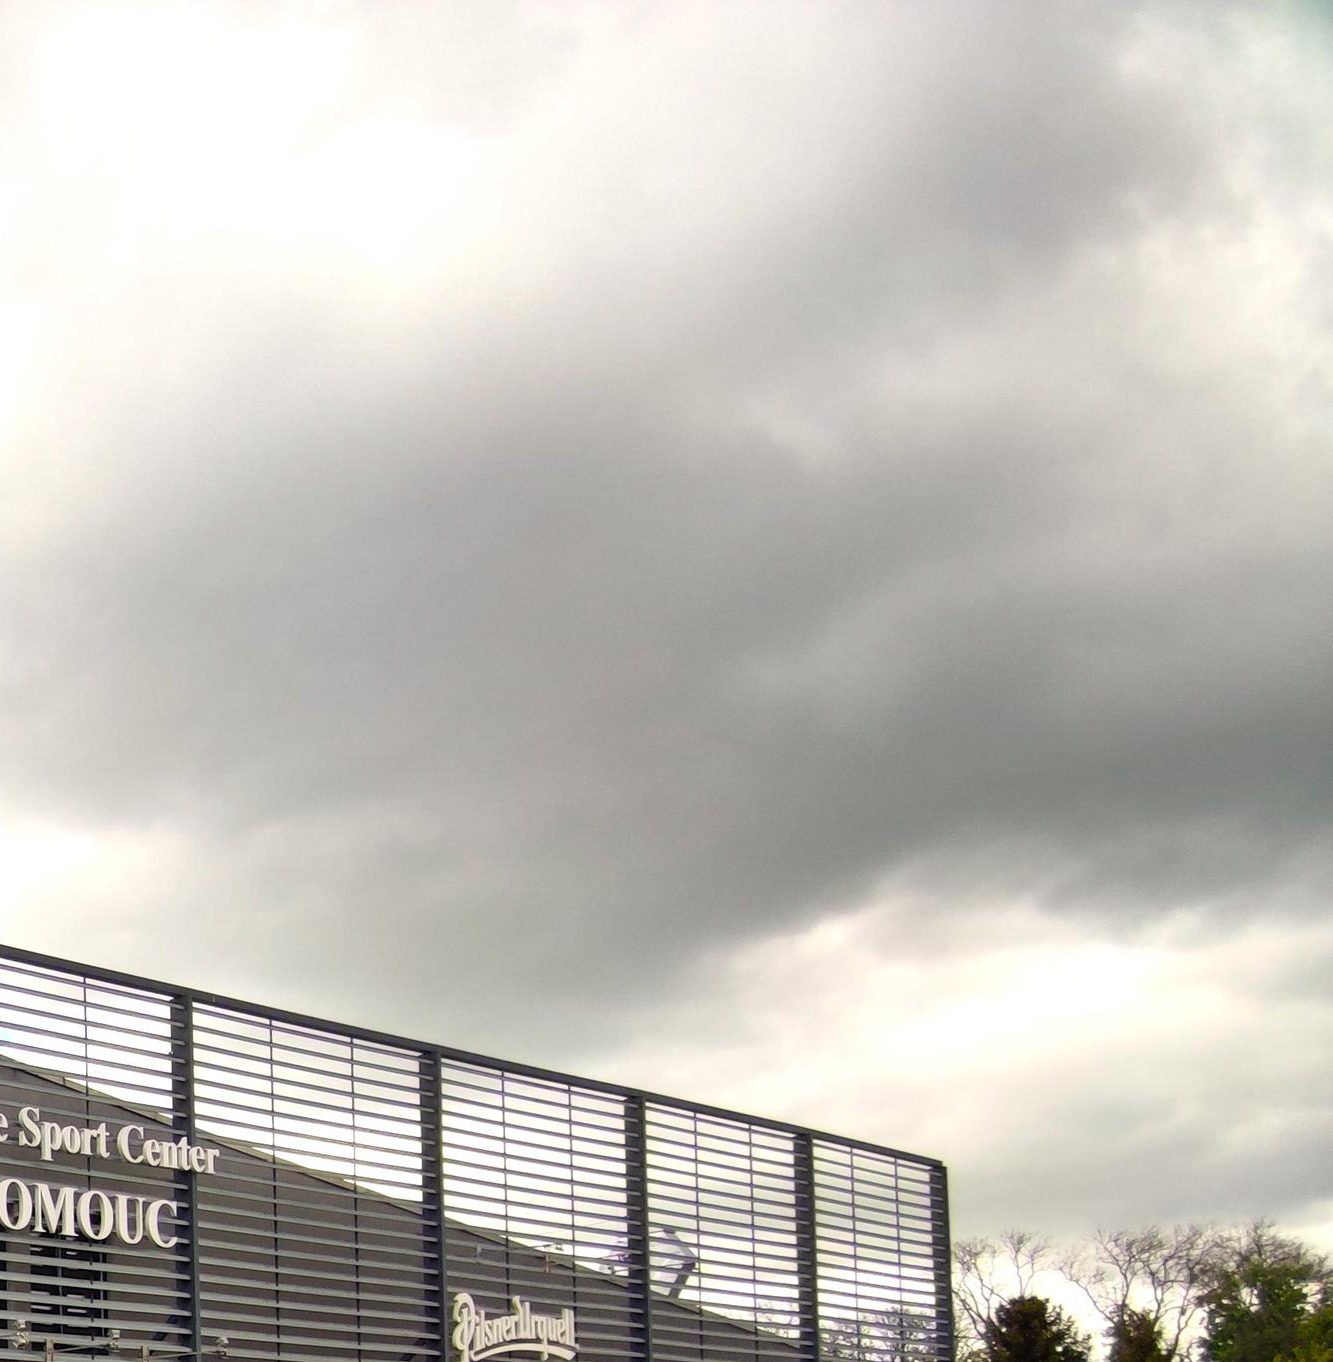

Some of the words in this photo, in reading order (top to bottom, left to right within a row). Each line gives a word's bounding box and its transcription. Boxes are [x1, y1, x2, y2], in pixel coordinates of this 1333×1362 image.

[18, 1106, 110, 1162] Sport
[117, 1124, 220, 1175] Center
[512, 1295, 580, 1361] Urquell
